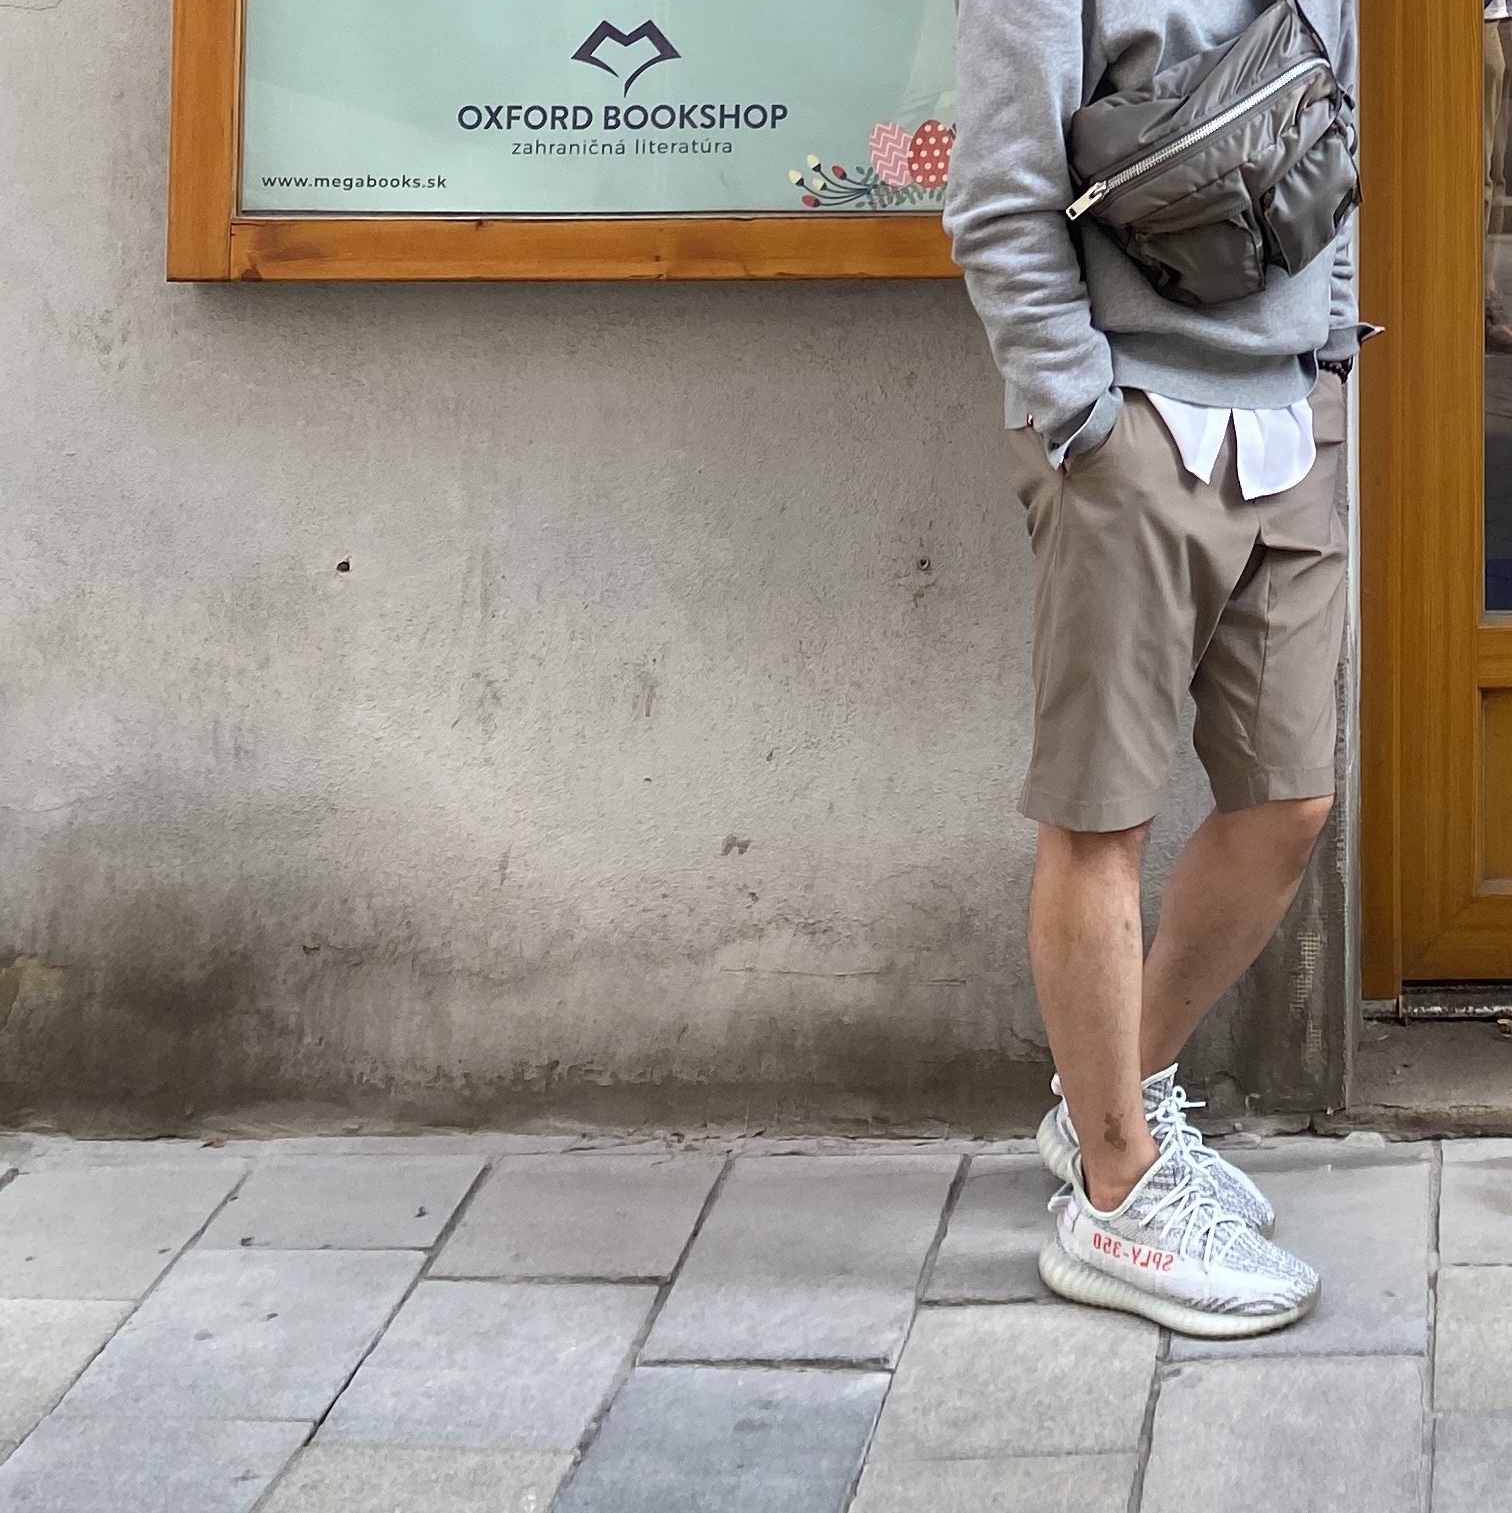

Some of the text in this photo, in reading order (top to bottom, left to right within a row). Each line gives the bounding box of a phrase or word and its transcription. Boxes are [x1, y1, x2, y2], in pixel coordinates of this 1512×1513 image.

[457, 103, 788, 131] OXFORD BOOKSHOP
[511, 137, 733, 156] zahraničná literatúra
[261, 174, 447, 191] www.megabooks.sk
